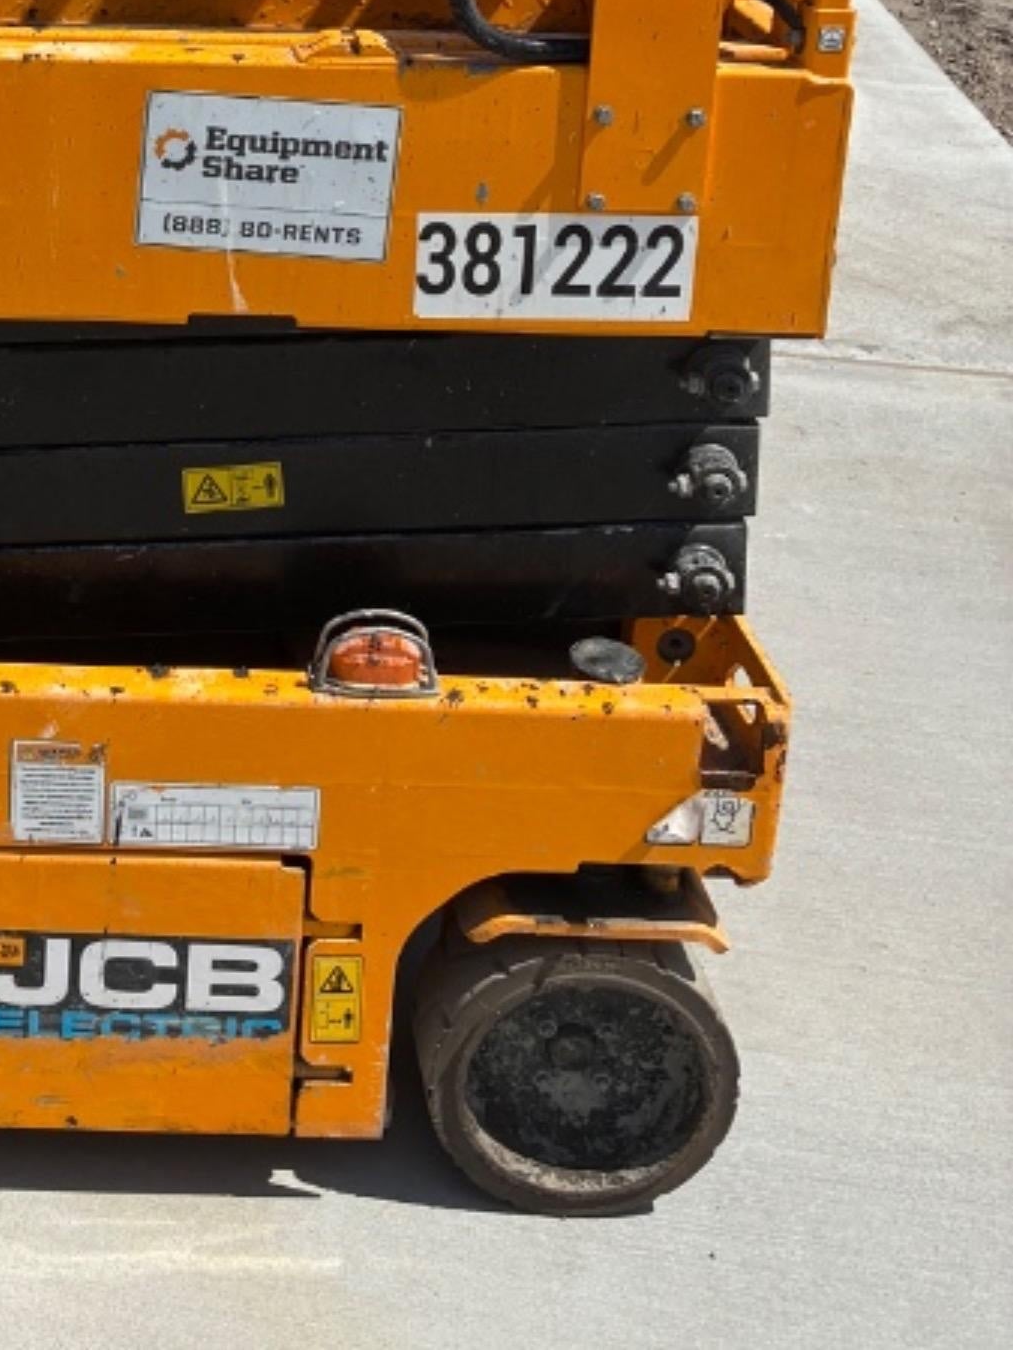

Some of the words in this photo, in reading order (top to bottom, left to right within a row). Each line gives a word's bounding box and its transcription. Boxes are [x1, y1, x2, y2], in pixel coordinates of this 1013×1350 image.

[204, 126, 390, 163] Equipment
[202, 155, 300, 185] Share
[416, 221, 686, 299] 381222
